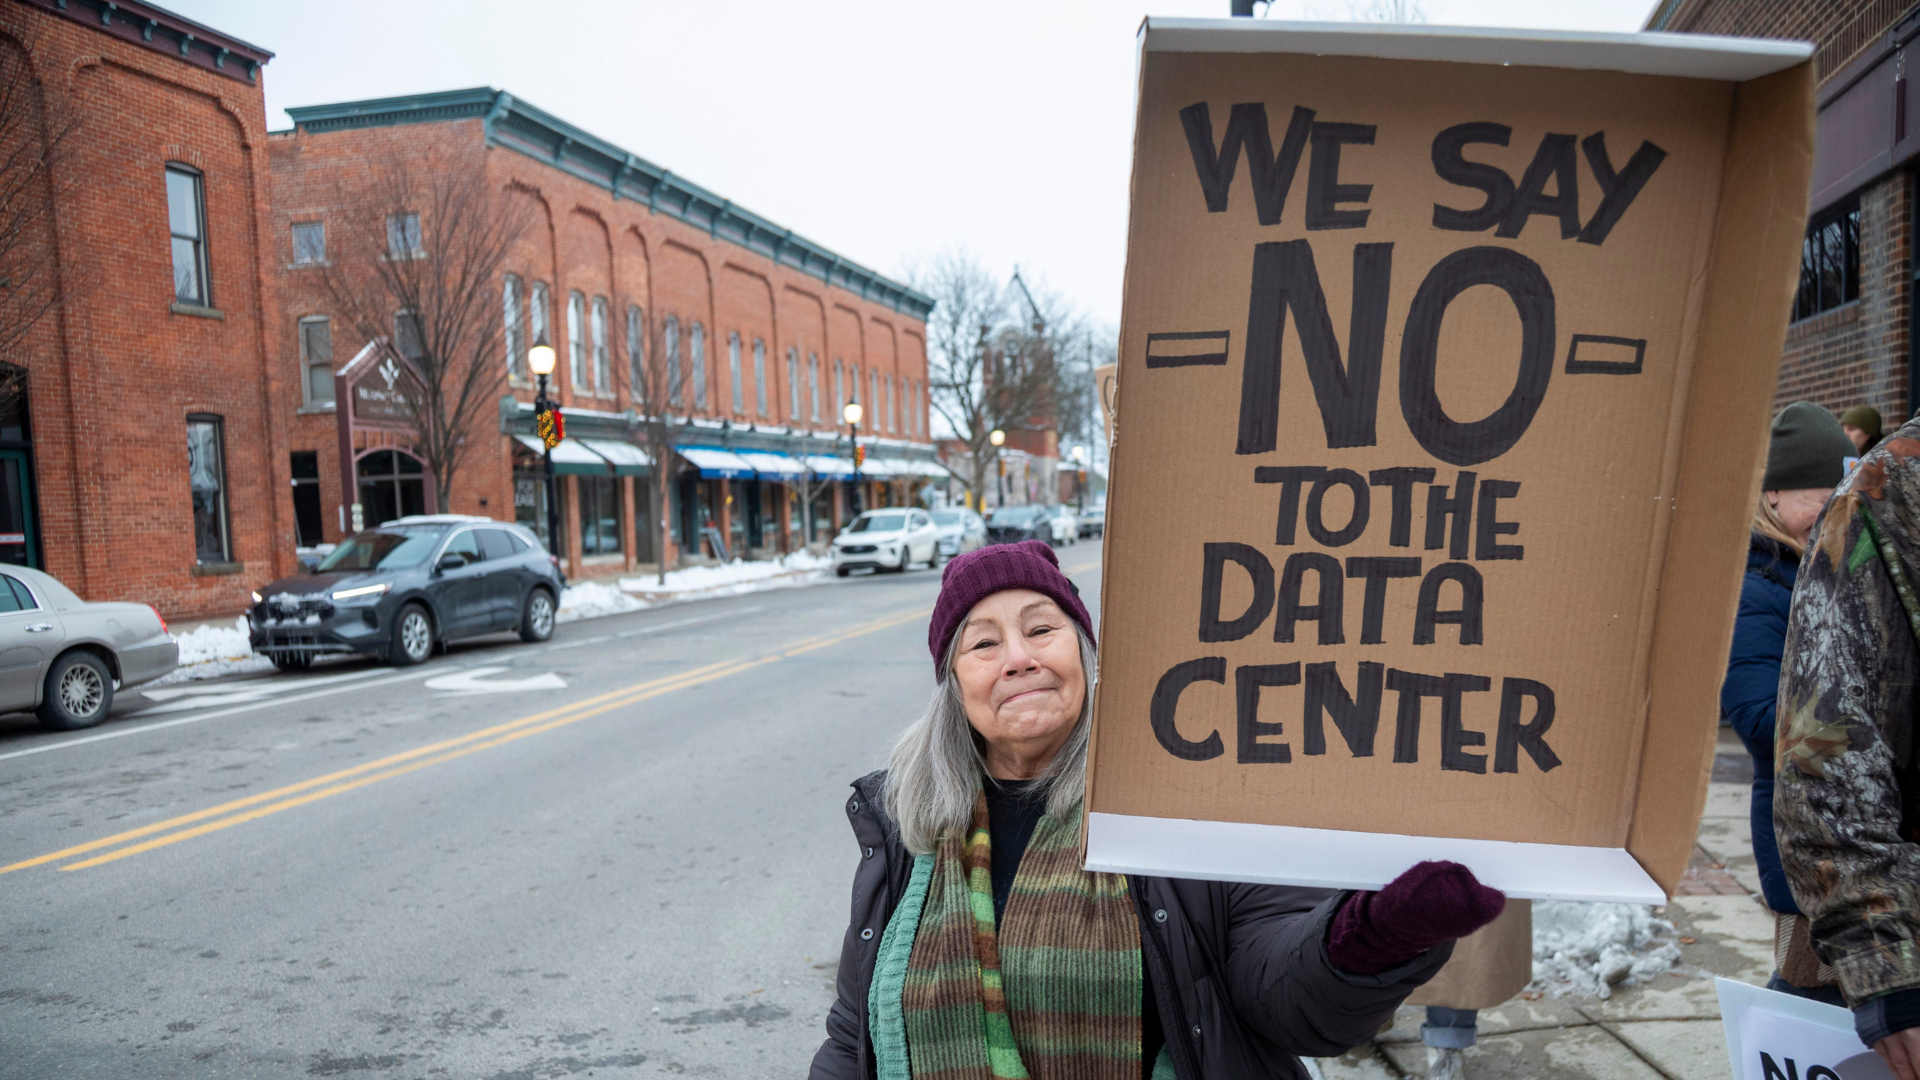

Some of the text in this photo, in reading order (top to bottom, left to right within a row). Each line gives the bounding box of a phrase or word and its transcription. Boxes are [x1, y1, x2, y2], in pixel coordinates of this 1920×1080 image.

[1179, 101, 1668, 246] WE SAY
[1235, 239, 1556, 467] NO
[514, 491, 535, 507] EASE
[1199, 541, 1484, 646] DATA
[1150, 656, 1562, 775] CENTER
